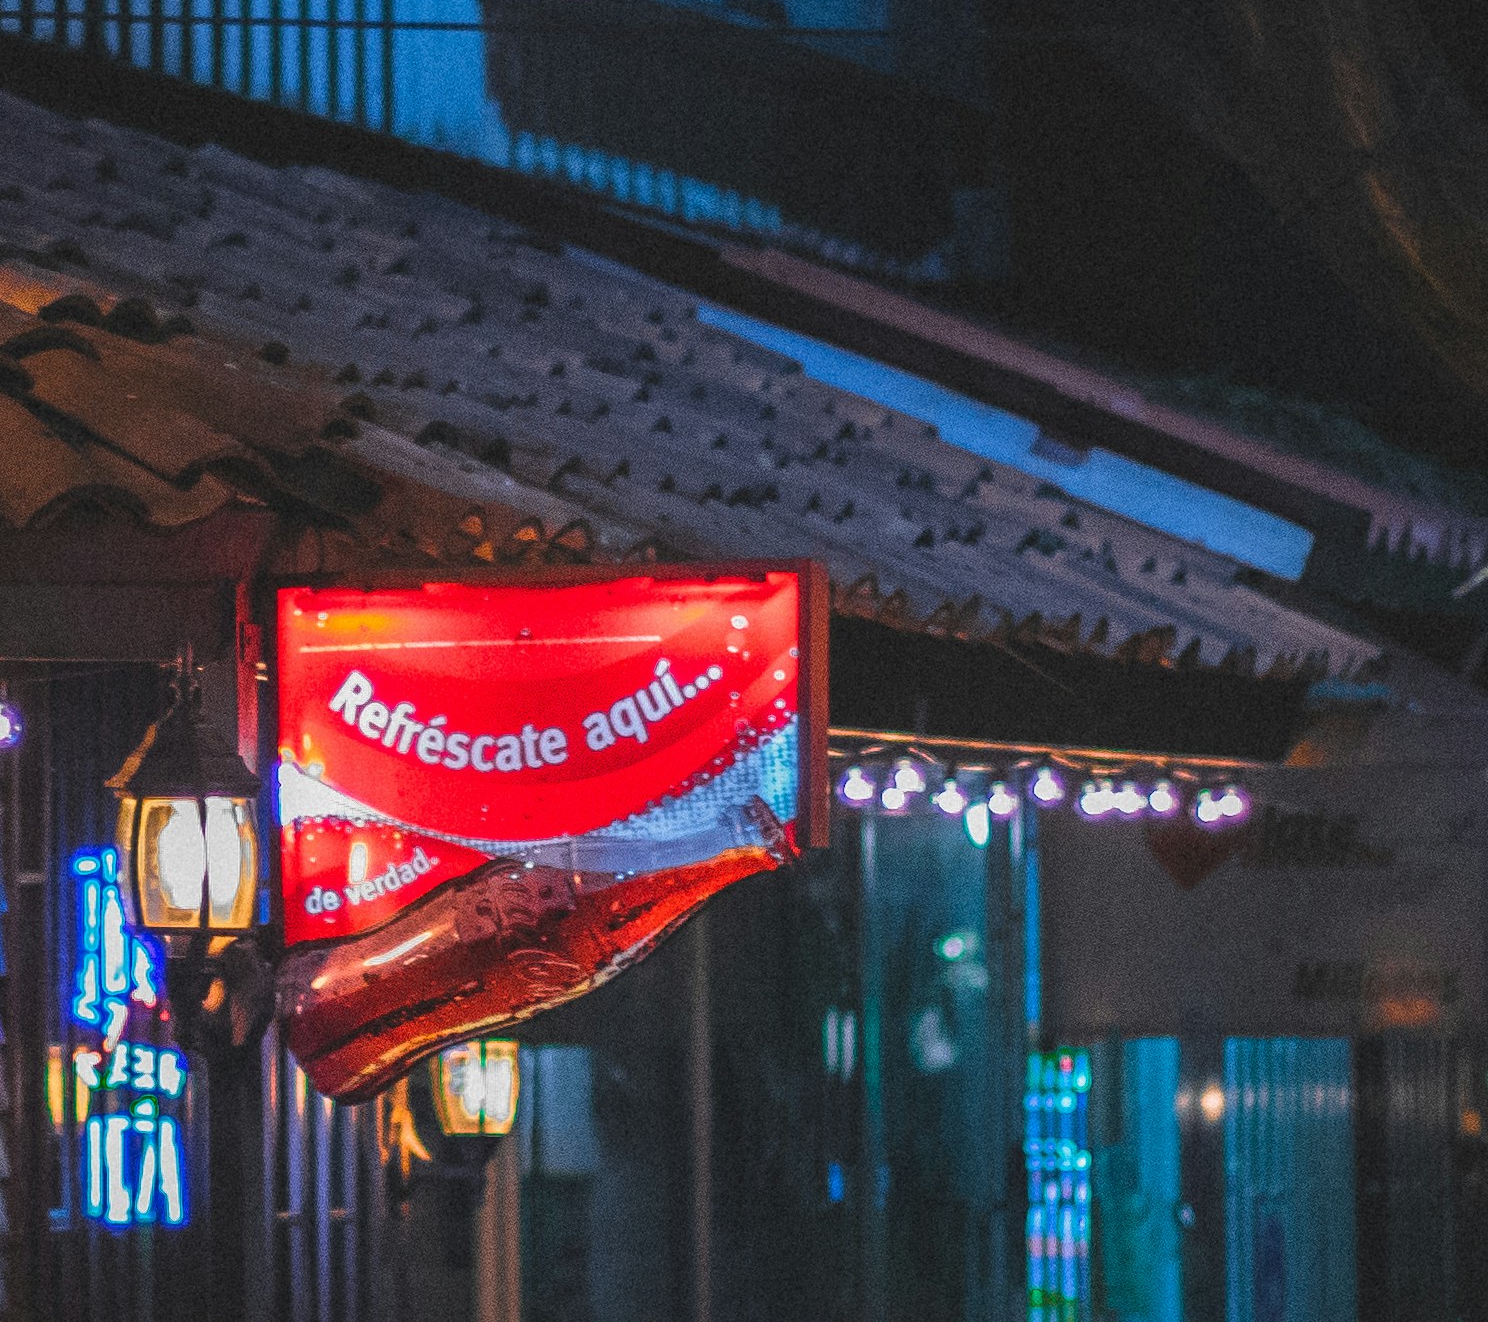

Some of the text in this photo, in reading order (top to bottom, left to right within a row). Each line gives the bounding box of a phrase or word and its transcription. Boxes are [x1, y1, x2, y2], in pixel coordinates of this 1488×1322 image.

[328, 657, 725, 774] Refréscate aquí...
[305, 887, 342, 915] de
